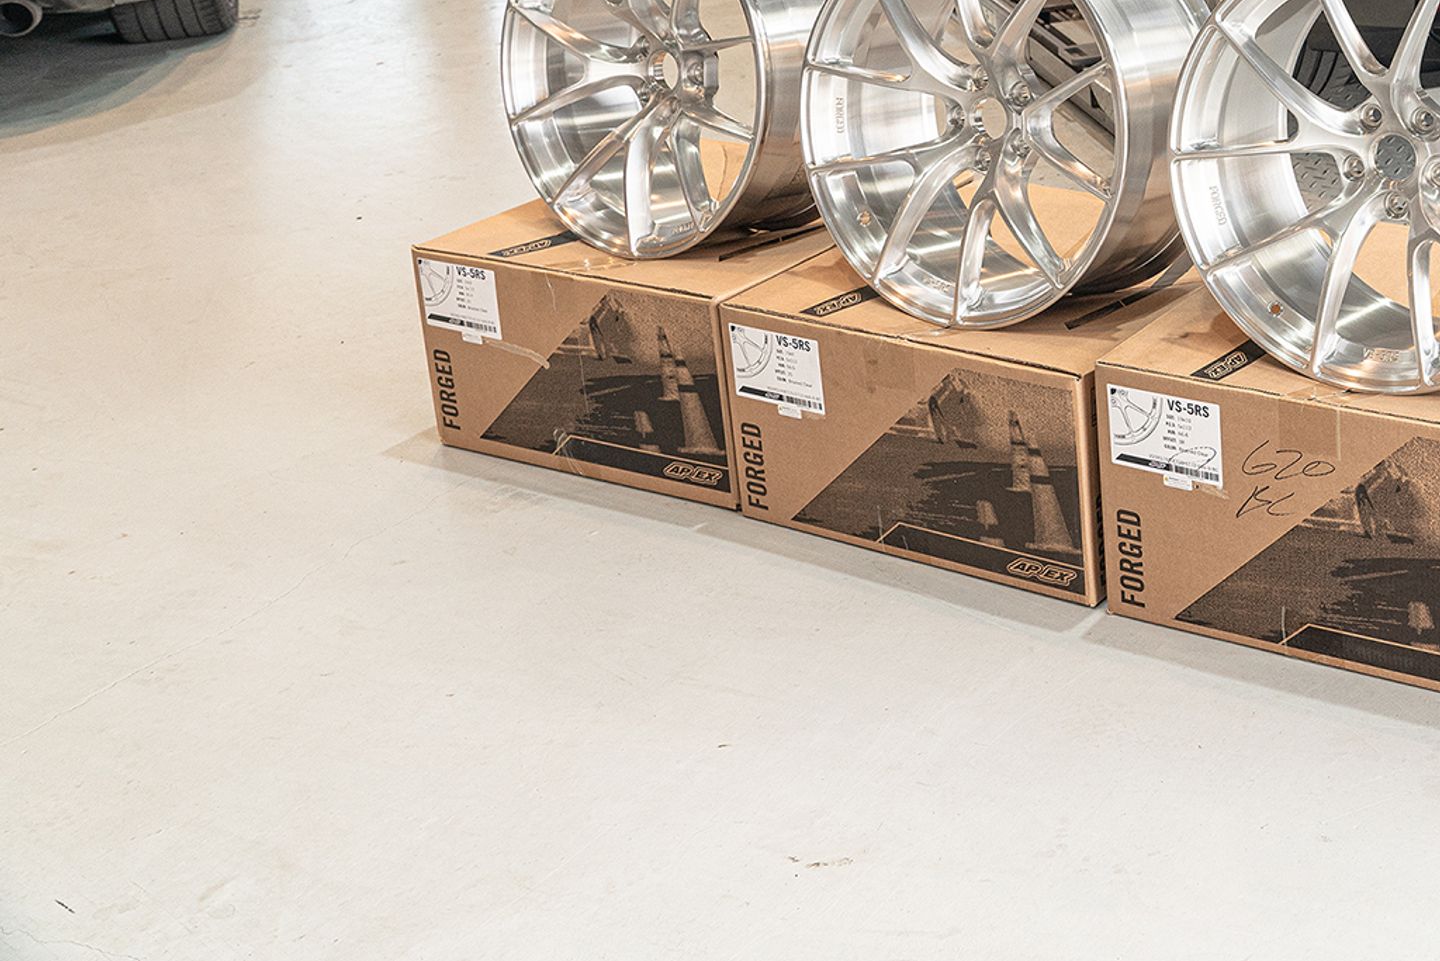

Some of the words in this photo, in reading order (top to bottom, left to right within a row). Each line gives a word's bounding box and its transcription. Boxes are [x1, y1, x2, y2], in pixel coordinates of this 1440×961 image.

[775, 335, 811, 352] VS-5RS
[433, 349, 461, 430] FORGED
[1167, 398, 1210, 418] VS-5RS
[663, 461, 723, 485] APEX
[741, 422, 769, 511] FORGED
[1007, 558, 1077, 586] APEX
[1117, 509, 1146, 608] FORGED
